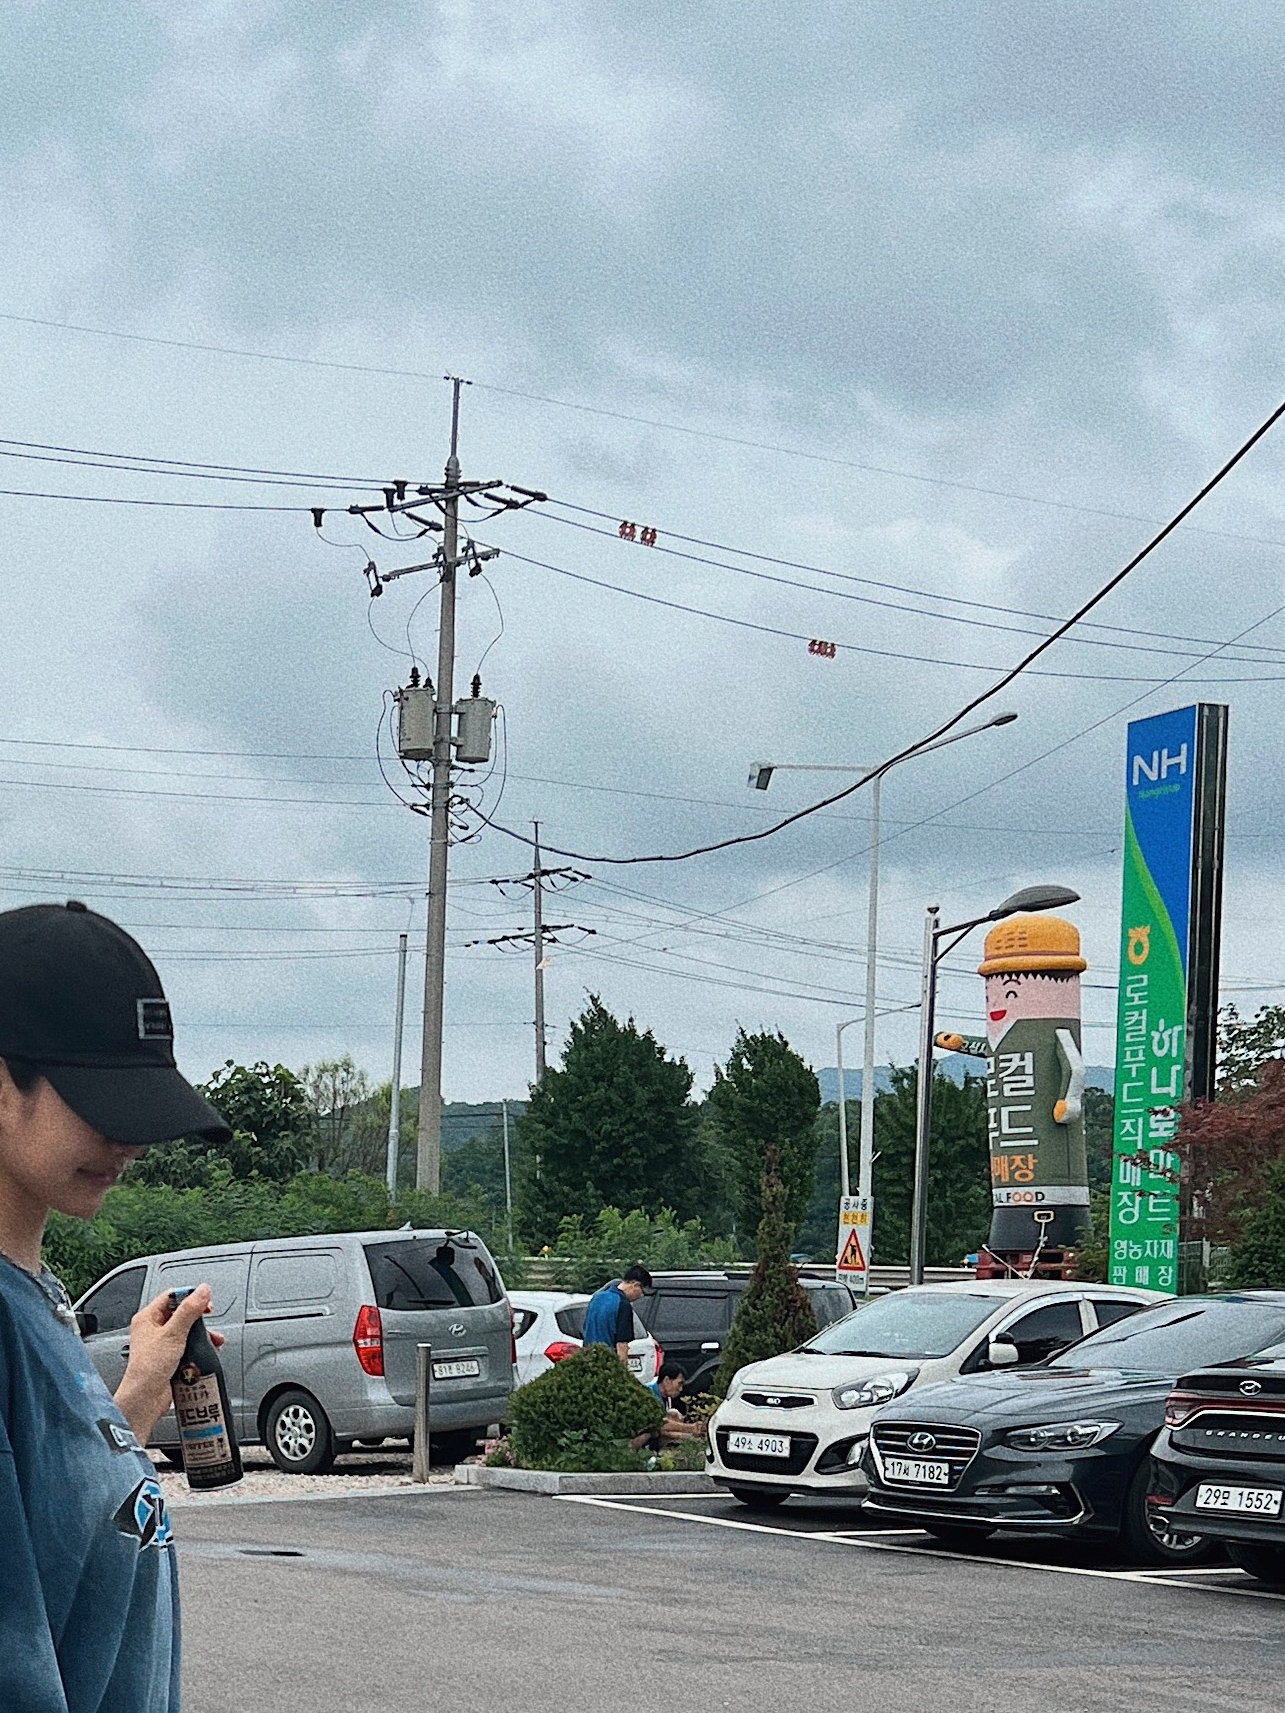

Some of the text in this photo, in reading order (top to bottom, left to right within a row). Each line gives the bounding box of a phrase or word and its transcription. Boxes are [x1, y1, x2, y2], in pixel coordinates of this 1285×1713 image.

[1132, 743, 1187, 785] NH
[1117, 974, 1148, 1224] 로컬푸드직매장
[1146, 1018, 1183, 1221] 하나로마트
[1005, 1191, 1046, 1203] FOOD
[1114, 1239, 1174, 1261] 영농자재
[757, 1438, 785, 1454] 4903
[914, 1463, 943, 1481] 7182
[1203, 1487, 1273, 1511] 29모 1552
